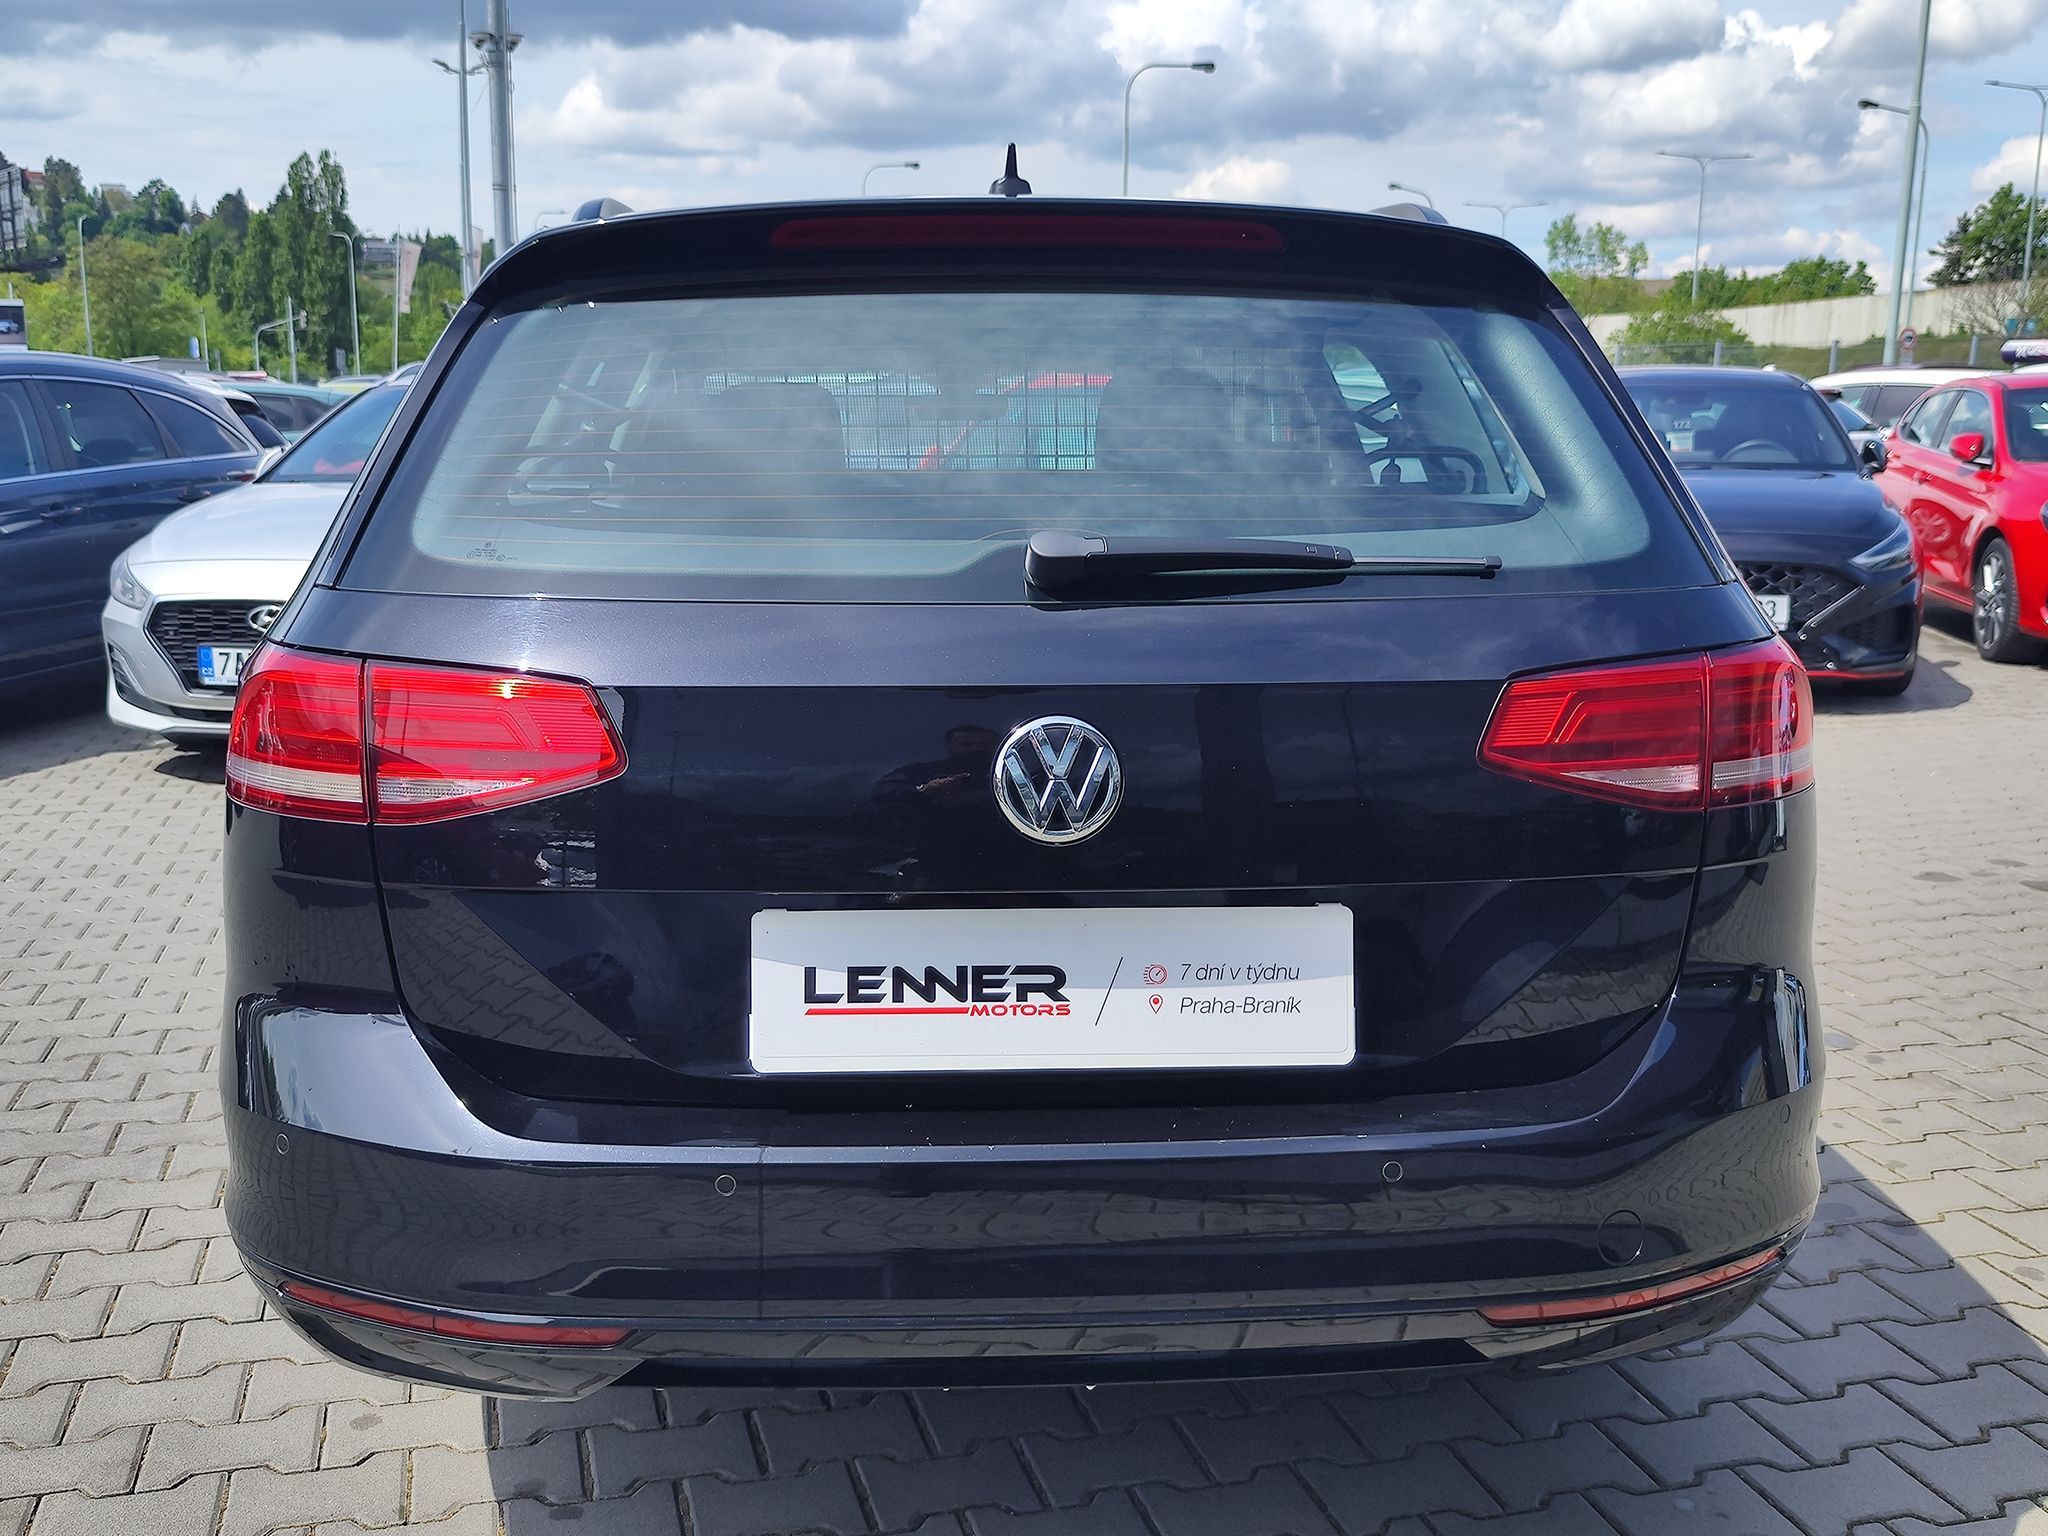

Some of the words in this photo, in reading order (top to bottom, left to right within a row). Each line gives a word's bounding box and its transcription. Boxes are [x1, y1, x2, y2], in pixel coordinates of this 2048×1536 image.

[803, 964, 1071, 1004] LENNER
[1180, 963, 1192, 981] 7
[1195, 963, 1226, 981] dní
[1230, 967, 1242, 981] v
[1246, 962, 1301, 985] týdnu
[969, 1003, 1071, 1017] MOTORS
[1179, 995, 1302, 1015] Praha-Braník
